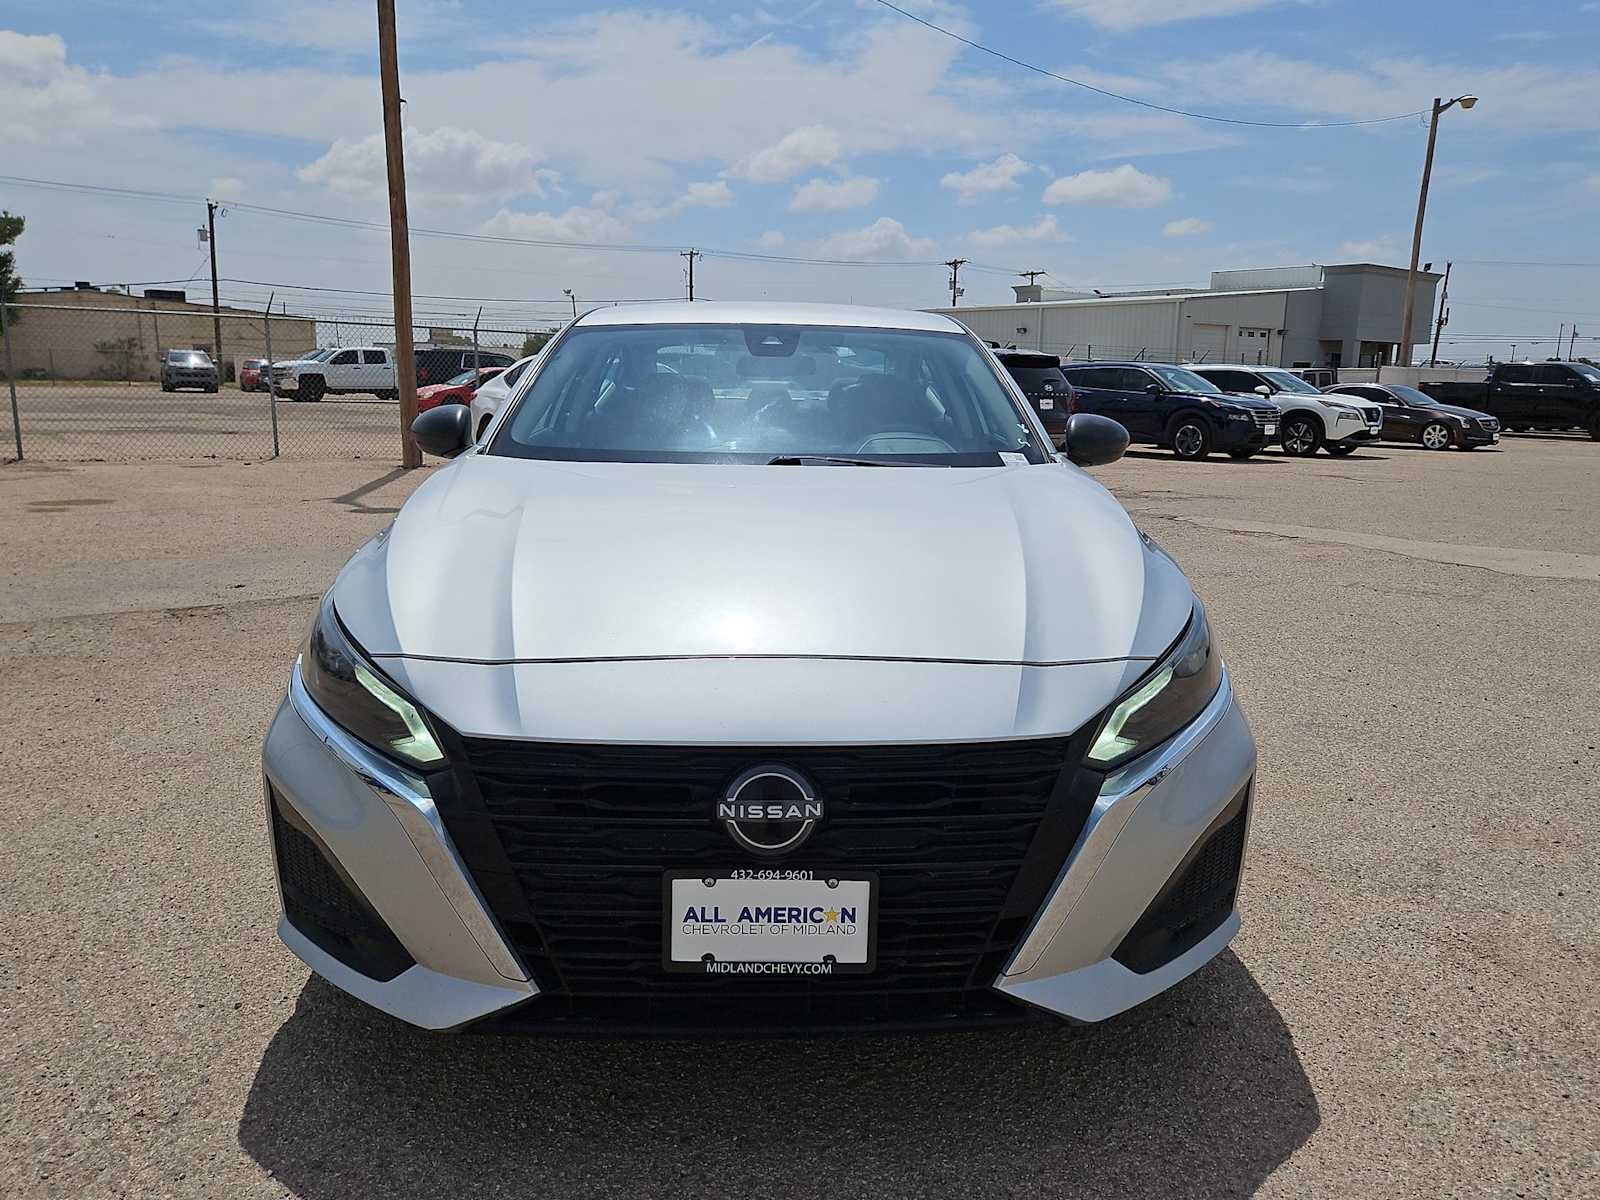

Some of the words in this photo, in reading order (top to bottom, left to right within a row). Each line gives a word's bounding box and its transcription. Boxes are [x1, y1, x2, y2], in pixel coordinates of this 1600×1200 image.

[719, 803, 821, 819] NISSAN
[730, 869, 814, 881] 432-694-9601
[682, 906, 727, 923] ALL
[682, 924, 765, 935] CHEVROLET
[769, 924, 790, 935] OF
[793, 924, 857, 935] MIDLAND
[706, 962, 833, 974] MIDLANDCHEVY.COM
